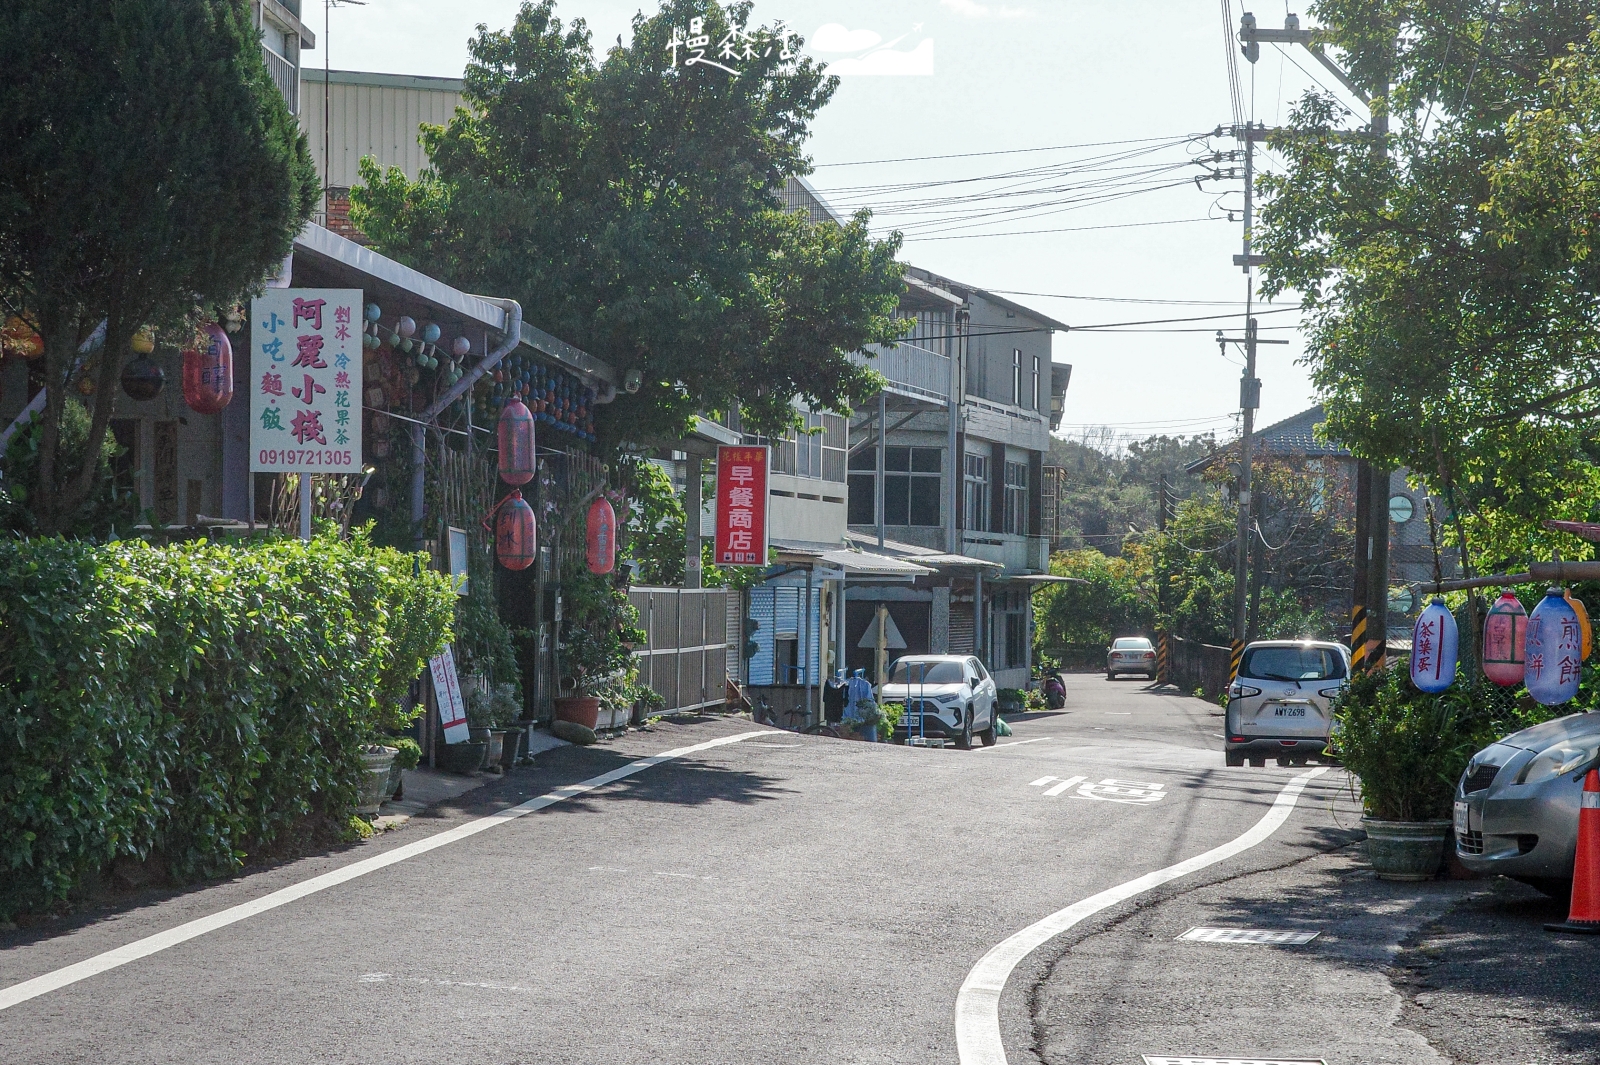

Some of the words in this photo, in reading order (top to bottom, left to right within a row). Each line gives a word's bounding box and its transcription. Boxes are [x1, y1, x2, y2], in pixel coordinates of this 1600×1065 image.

[290, 297, 327, 446] 阿麗小棧
[259, 449, 352, 466] 0919721305
[727, 465, 754, 550] 早餐商店
[1417, 620, 1435, 673] 茶葉蛋
[1557, 616, 1581, 686] 煎餅
